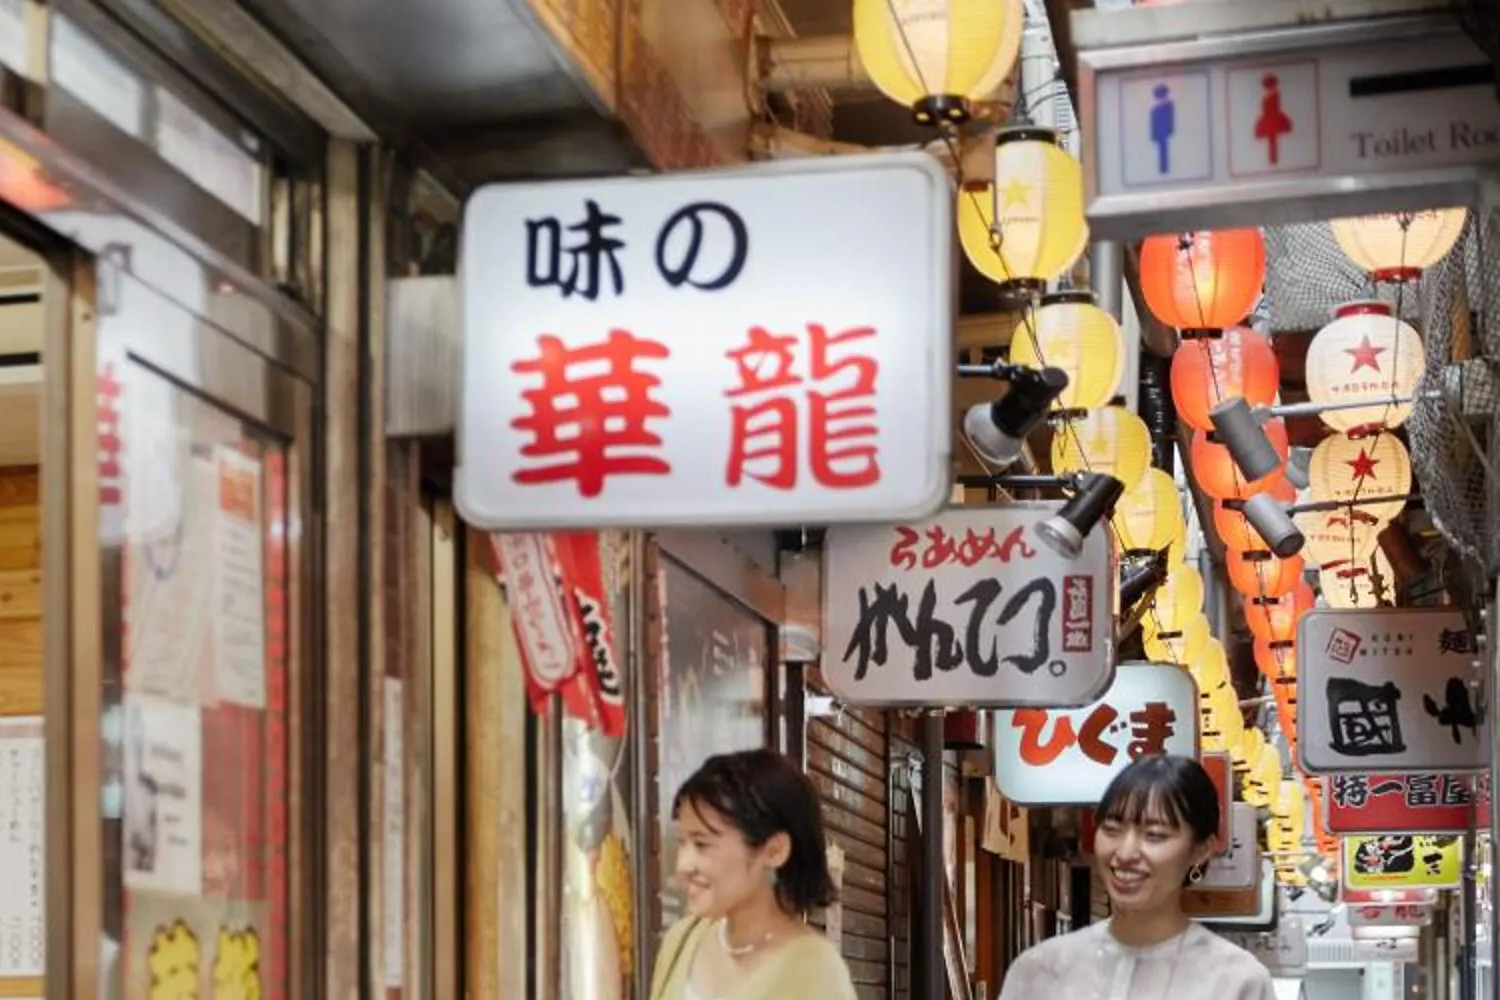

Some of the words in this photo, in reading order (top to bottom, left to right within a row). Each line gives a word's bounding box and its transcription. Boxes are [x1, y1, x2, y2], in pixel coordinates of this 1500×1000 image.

[1350, 126, 1437, 160] Toilet
[526, 199, 749, 301] 味の
[510, 322, 881, 498] 華龍
[890, 525, 1036, 571] らあめん
[1012, 703, 1177, 767] ひぐま
